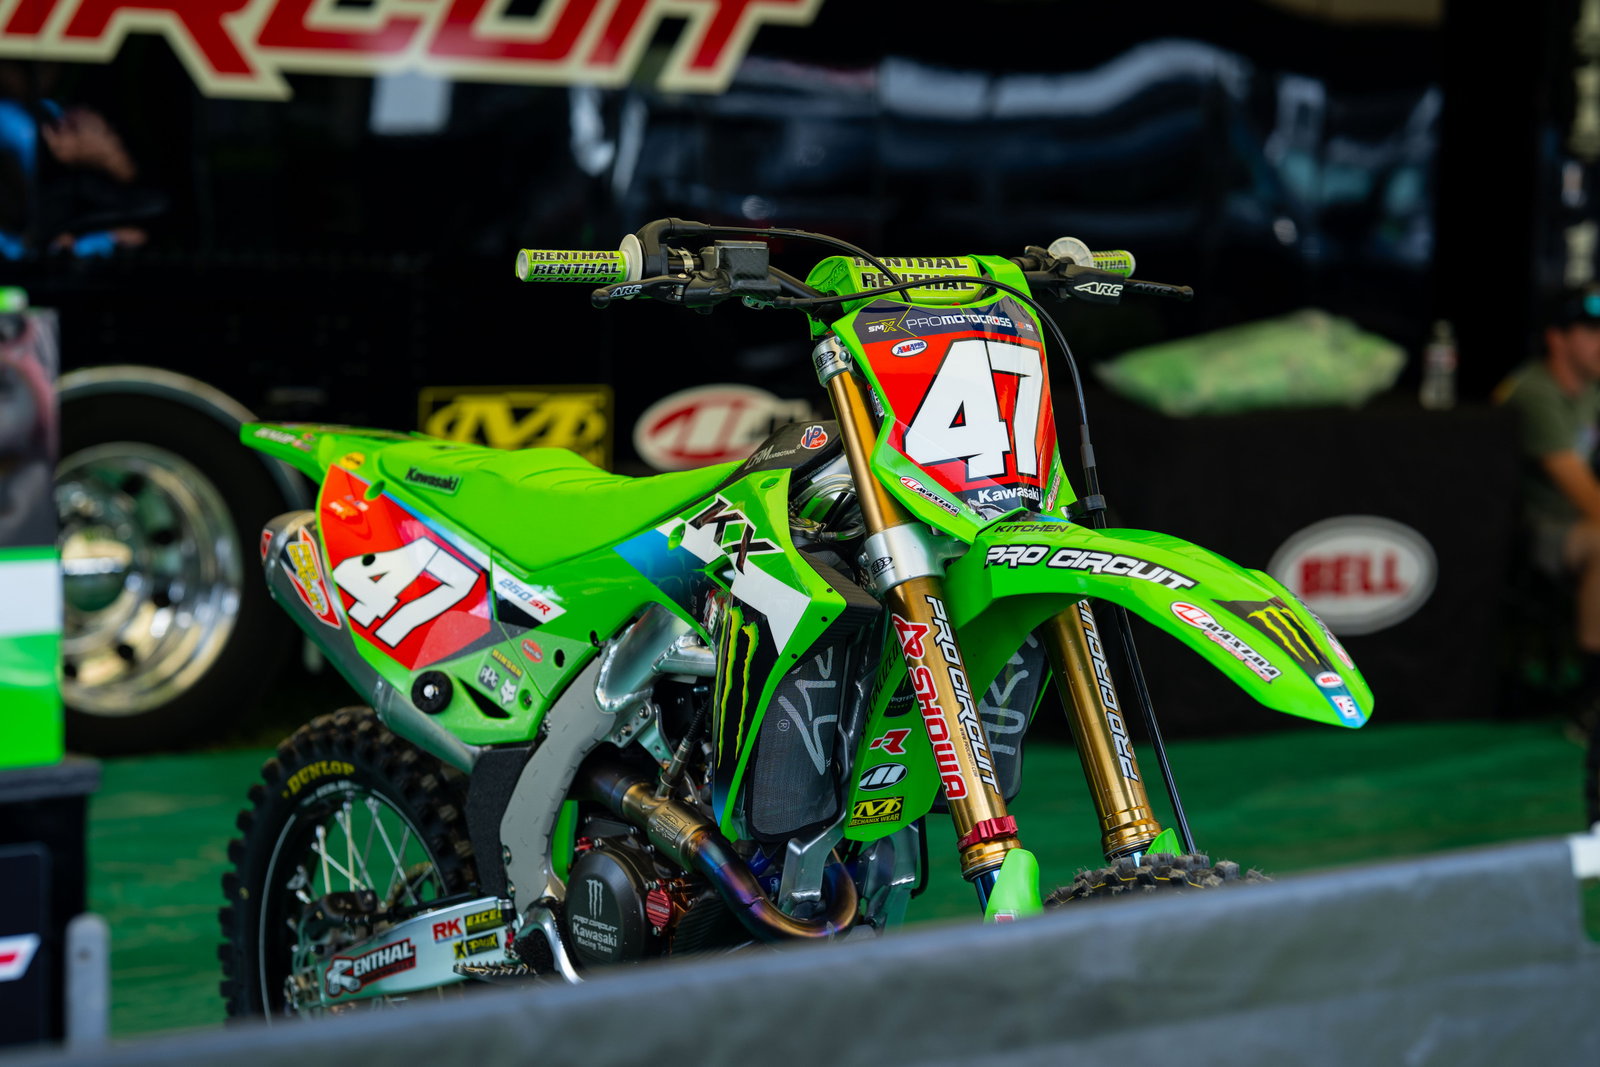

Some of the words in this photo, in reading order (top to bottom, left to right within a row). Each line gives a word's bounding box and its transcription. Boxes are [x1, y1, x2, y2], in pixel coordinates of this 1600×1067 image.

[532, 252, 619, 260] RENTHAL
[533, 263, 621, 275] RENTHAL
[610, 285, 642, 297] ARC
[1074, 282, 1123, 297] ARC
[868, 321, 897, 333] SMX
[904, 338, 1043, 482] 47
[405, 467, 459, 490] Kawasaki
[978, 486, 1039, 504] Kawasaki
[686, 495, 778, 576] KX
[994, 524, 1069, 533] KITCHEN
[984, 545, 1049, 570] PRO
[1047, 549, 1199, 591] CIRCUIT
[1298, 554, 1407, 599] BELL
[332, 536, 480, 648] 47
[1201, 616, 1282, 680] MAXIMA
[925, 595, 961, 668] PRO
[947, 665, 1000, 795] CIRCUIT
[908, 664, 968, 800] SHOWA
[1106, 710, 1140, 782] PRO
[287, 761, 354, 795] DUNLOP
[433, 919, 464, 942] RK
[573, 922, 617, 947] Kawasaki
